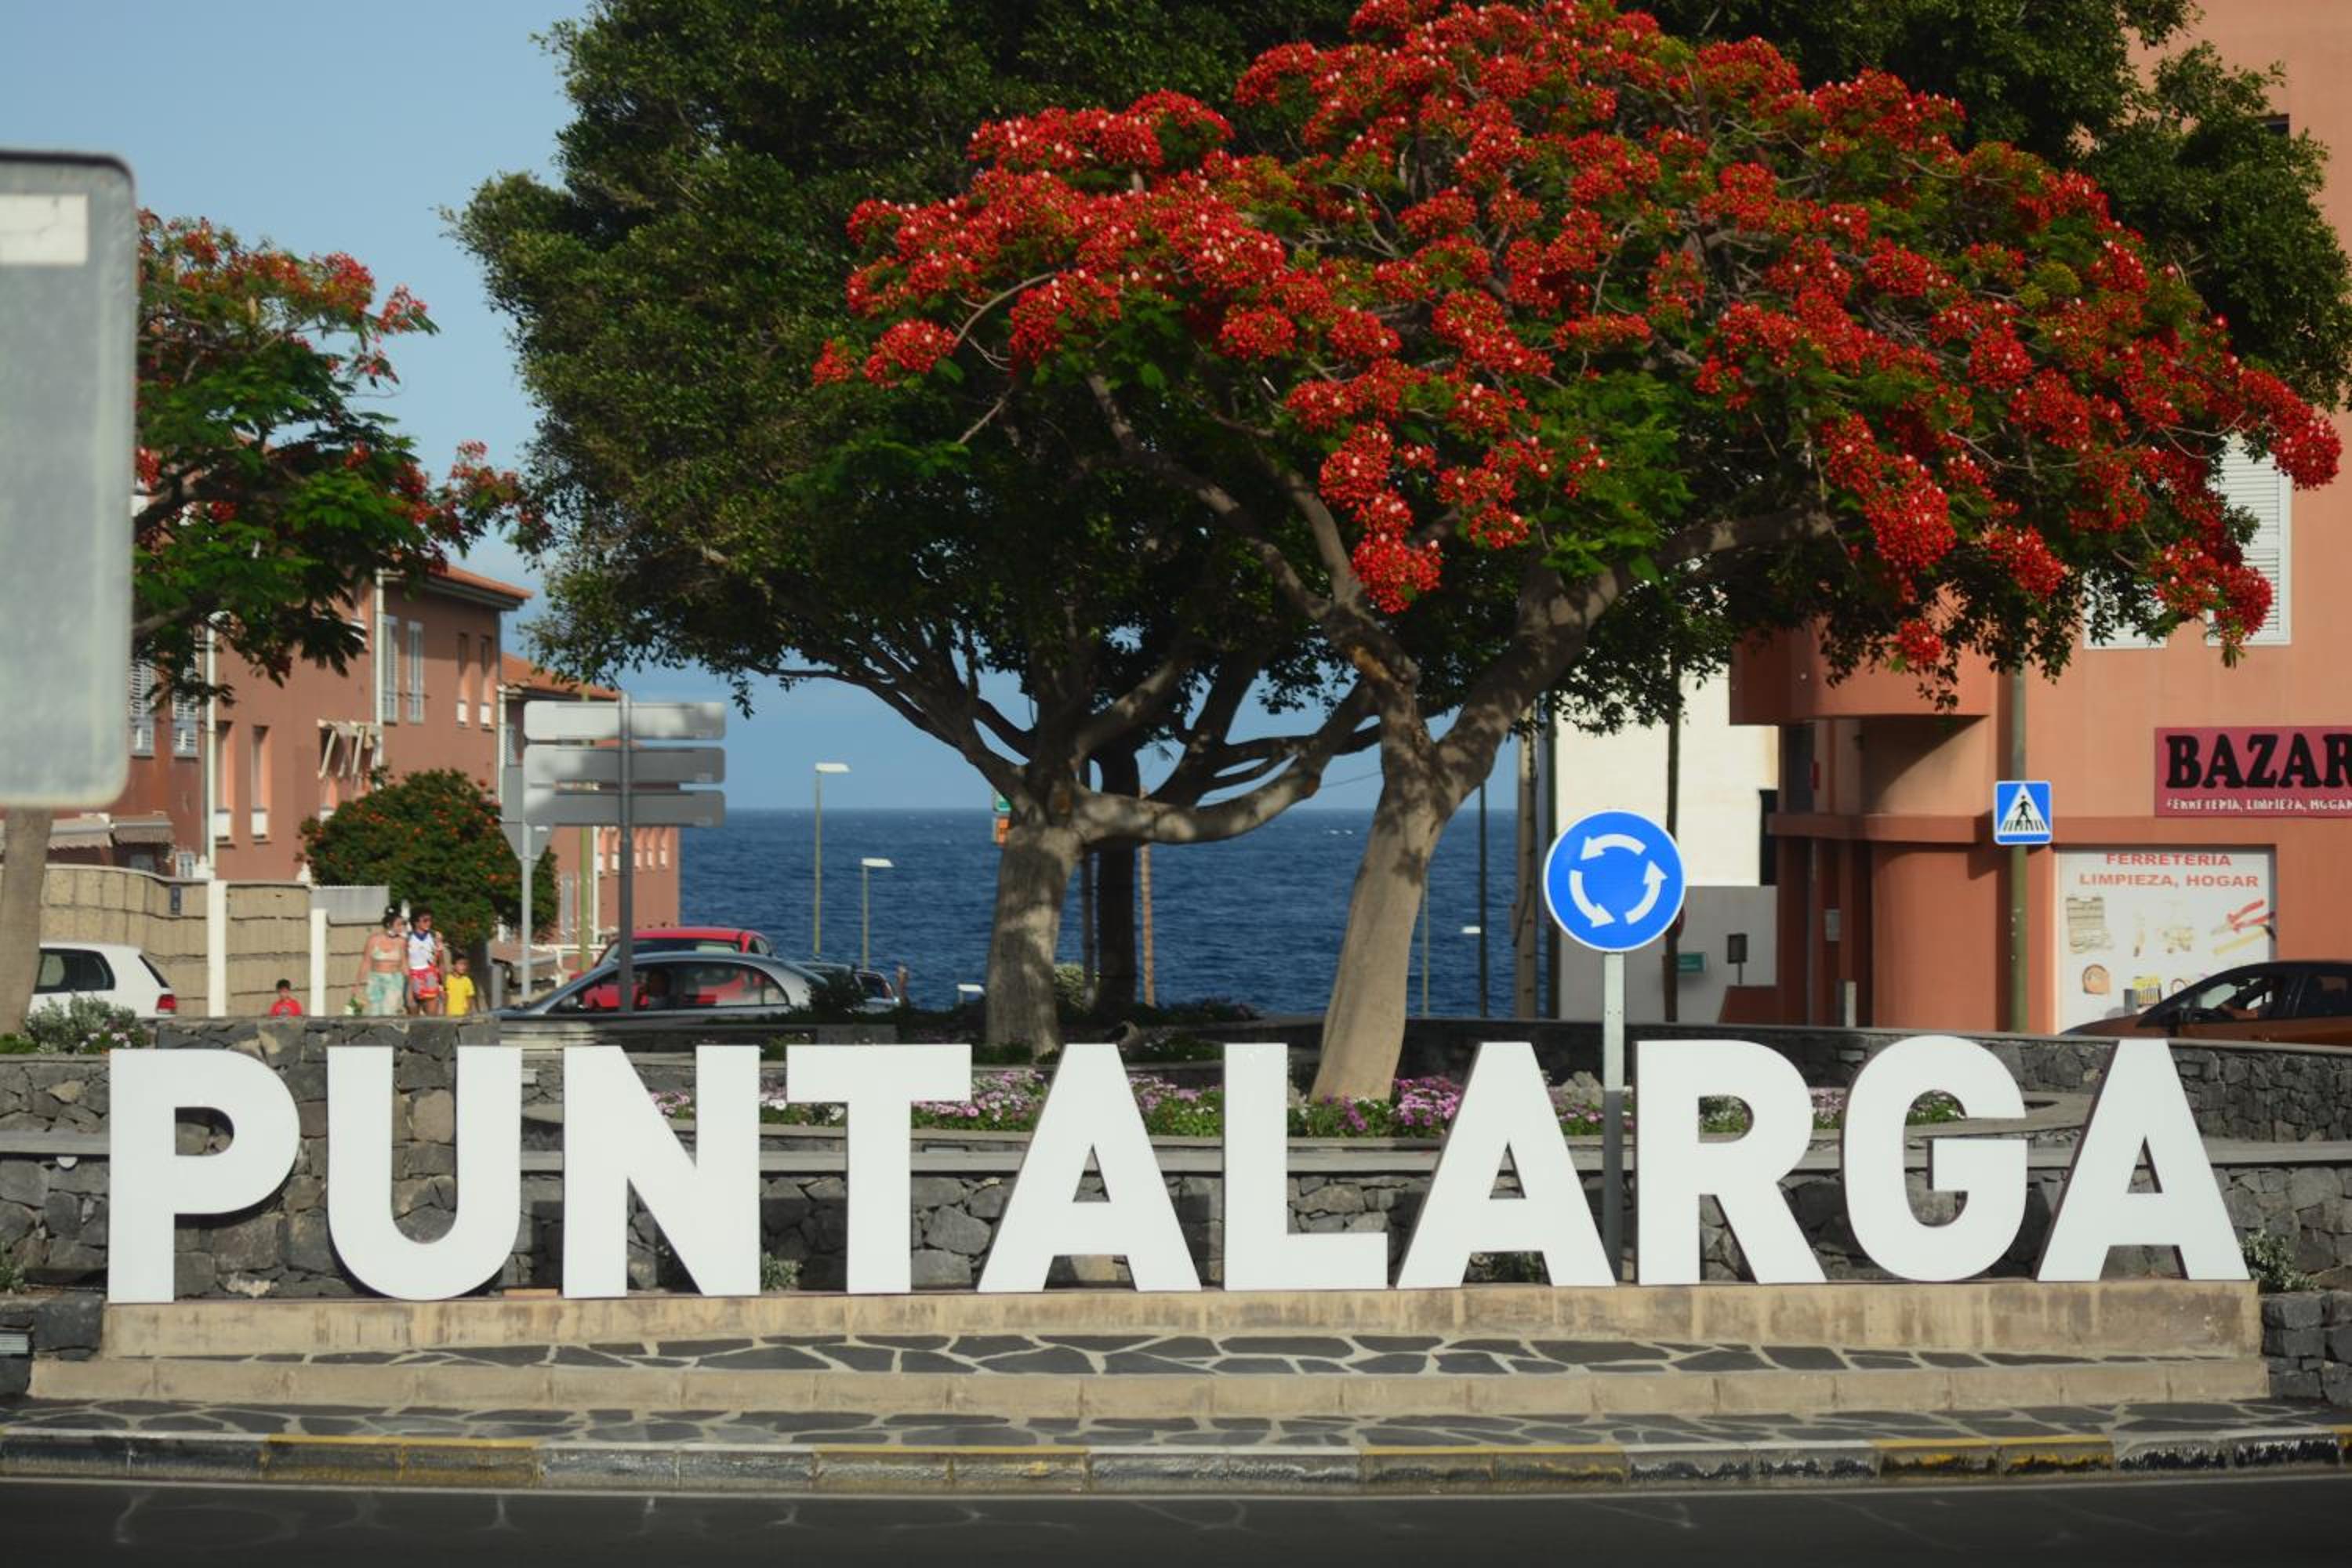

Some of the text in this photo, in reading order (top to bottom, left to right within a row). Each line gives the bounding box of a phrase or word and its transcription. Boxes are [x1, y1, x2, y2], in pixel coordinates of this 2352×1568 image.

[2165, 733, 2352, 789] BAZAR
[2106, 853, 2232, 866] FERRETERIA
[2078, 873, 2259, 887] LIMPIEZA, HOGAR
[106, 1034, 2252, 1303] PUNTALARGA
